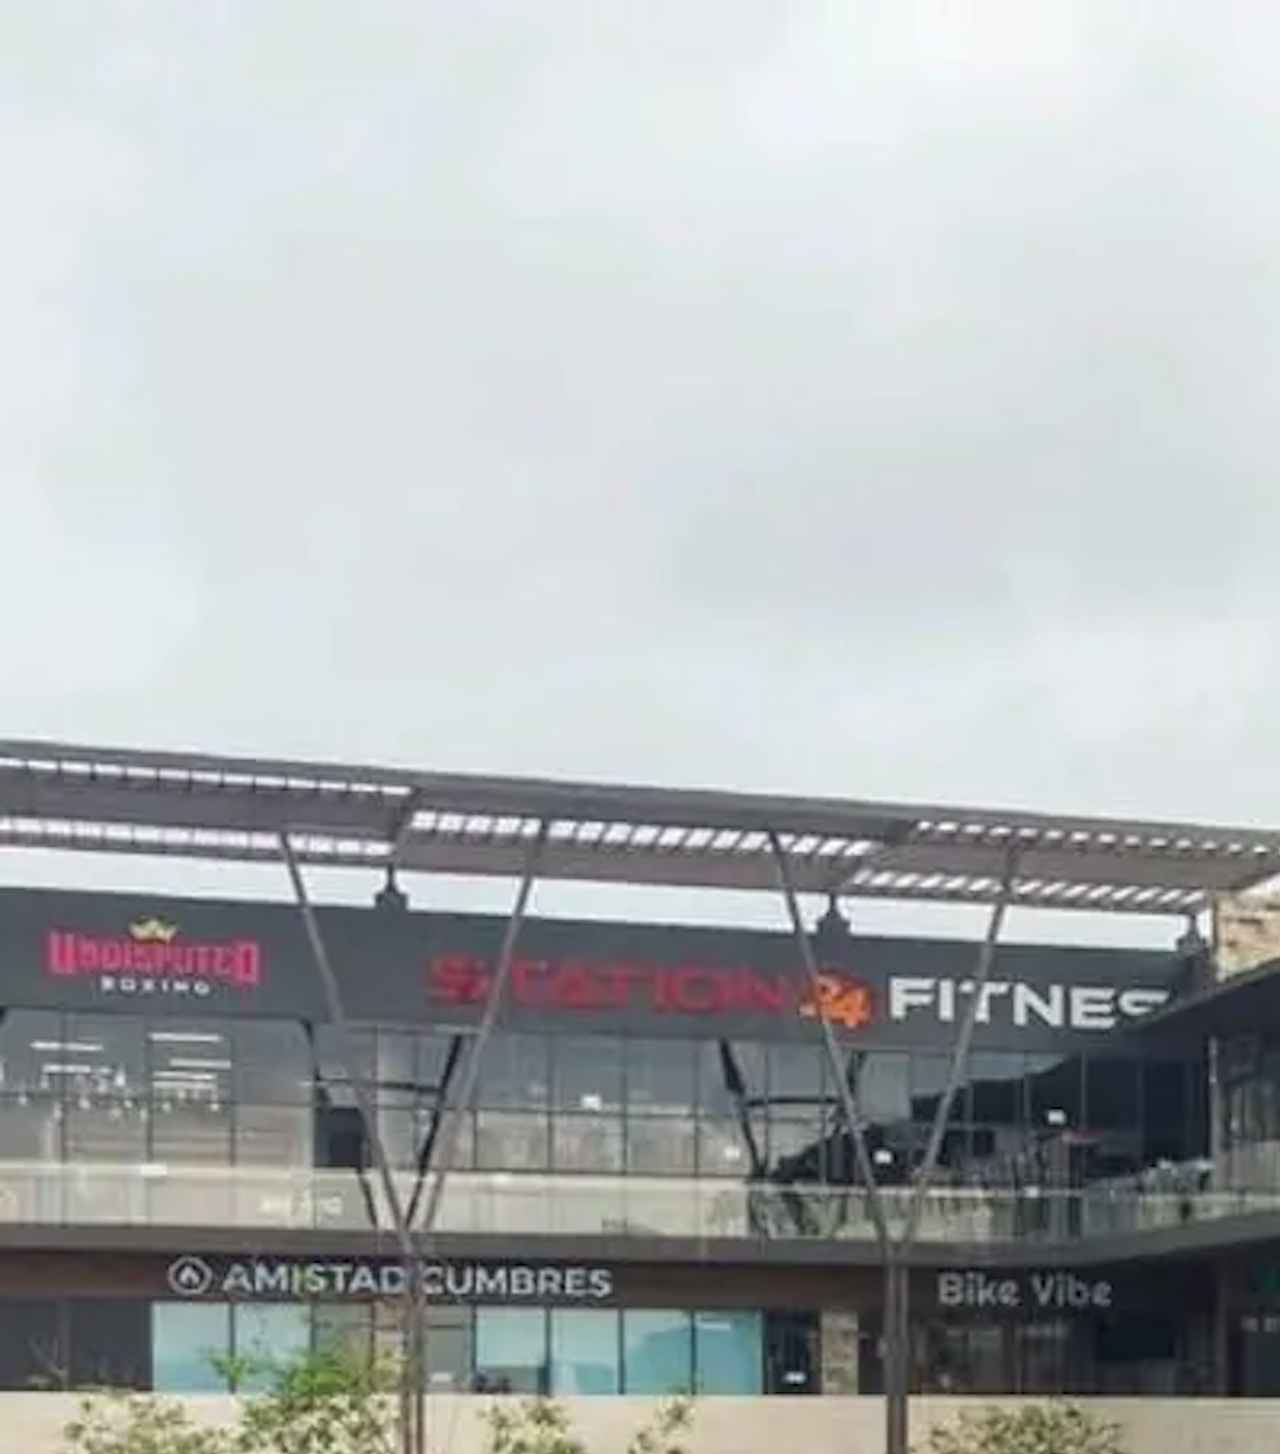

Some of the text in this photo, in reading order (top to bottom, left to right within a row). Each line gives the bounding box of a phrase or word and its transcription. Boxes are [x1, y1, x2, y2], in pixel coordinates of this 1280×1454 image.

[430, 956, 786, 1013] STATION
[221, 1261, 612, 1298] AMISTAD CUMBRES
[938, 1271, 1114, 1307] Bike Vibe
